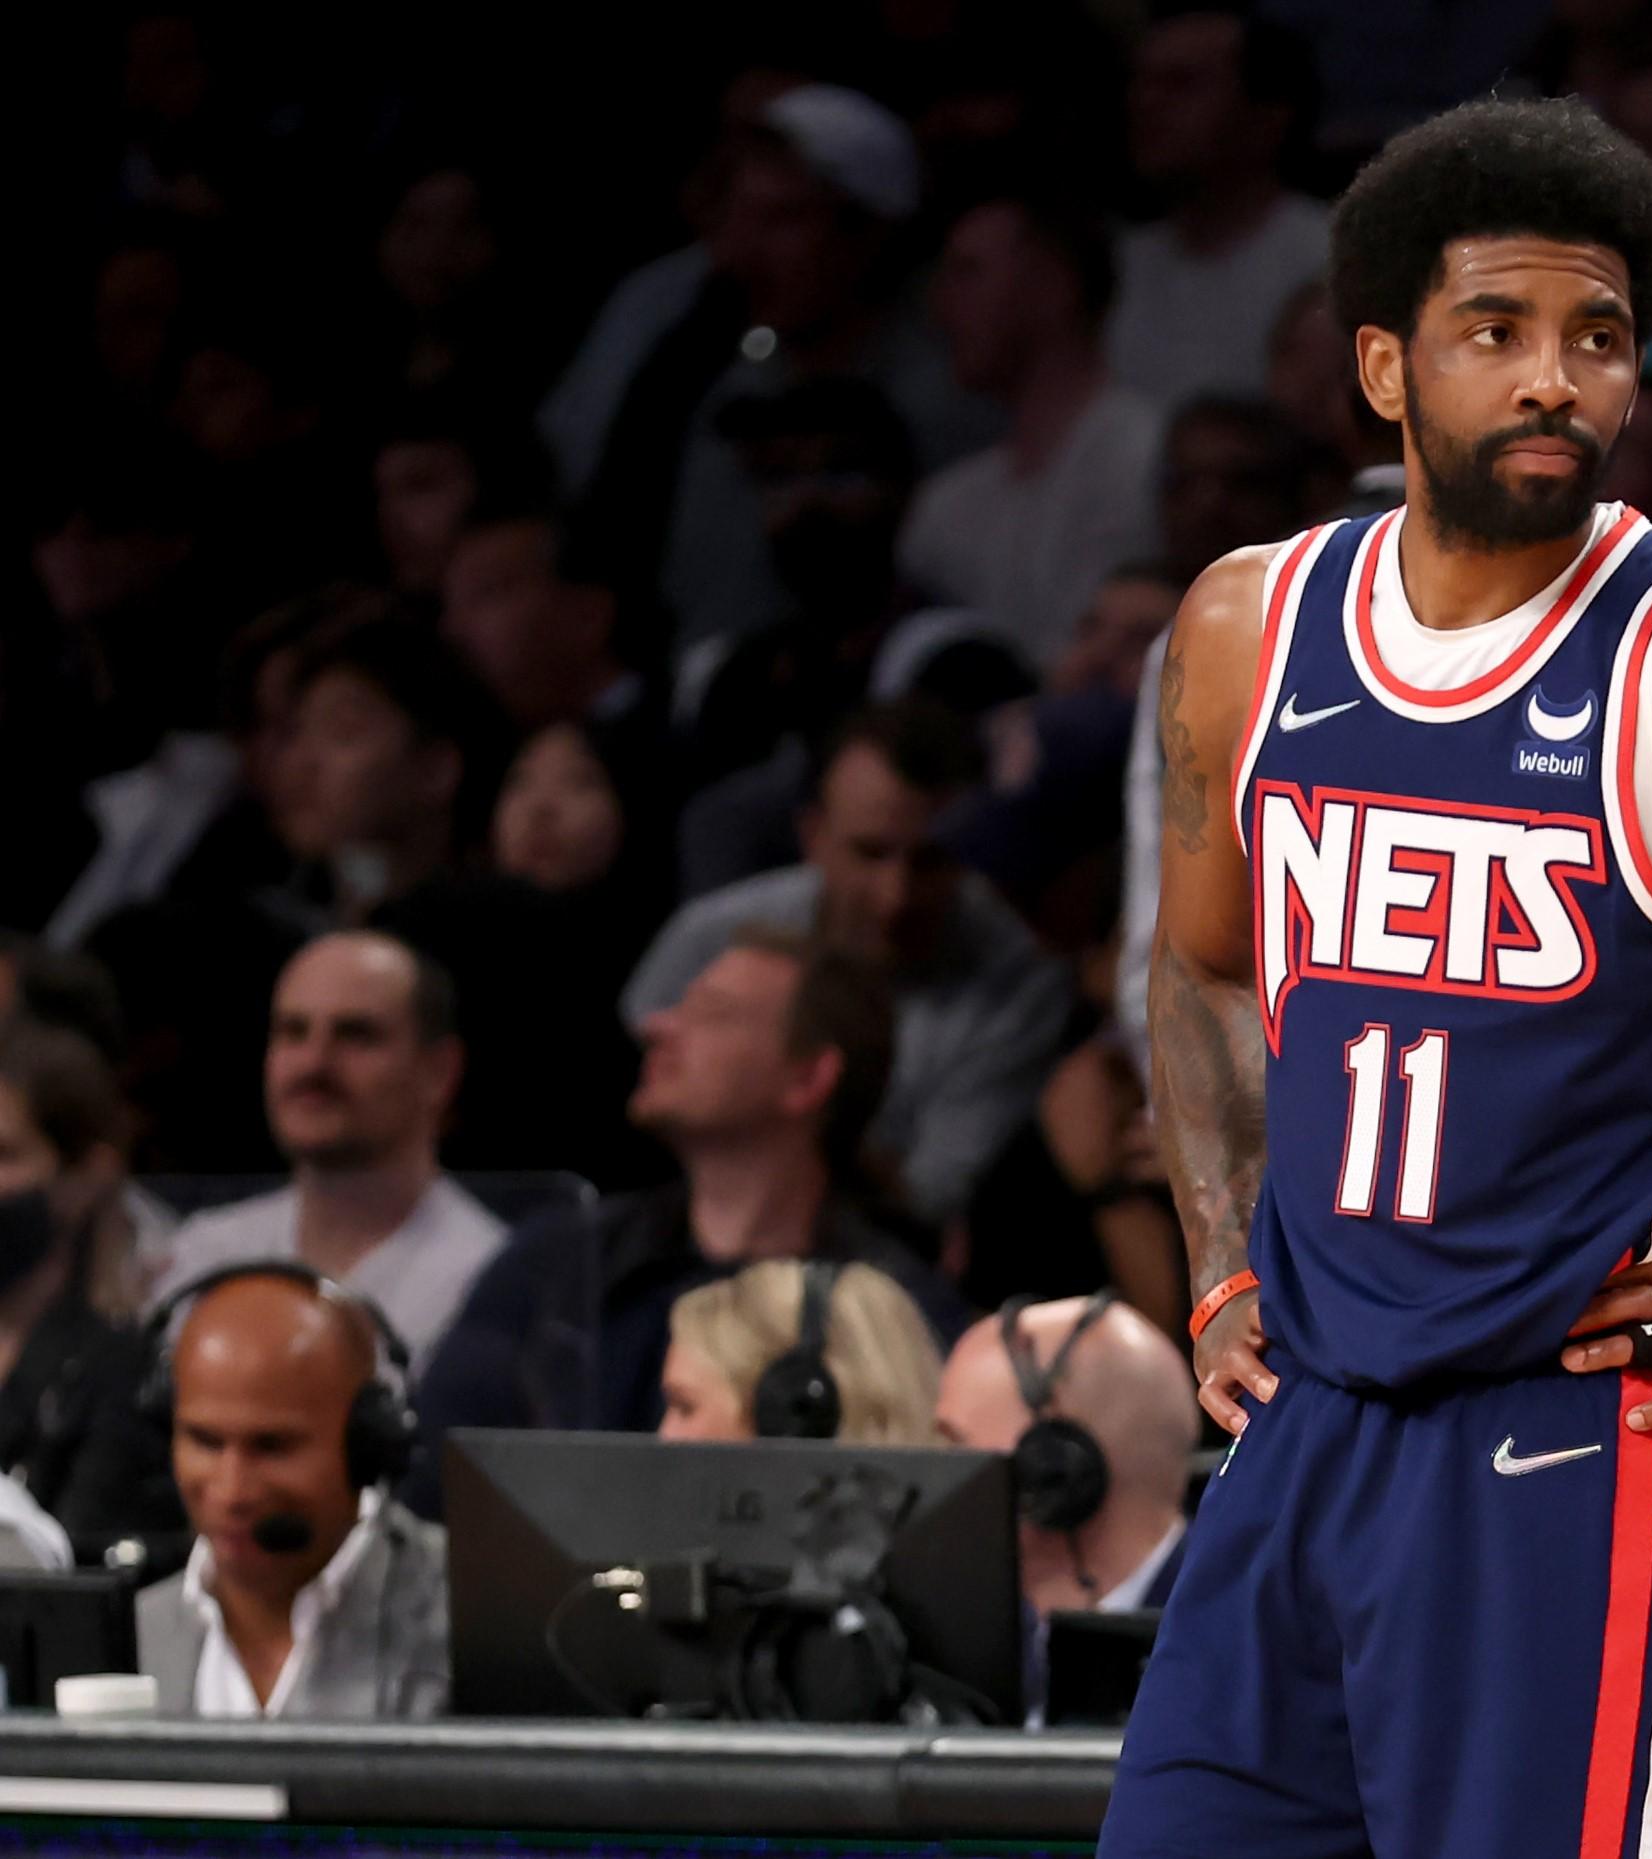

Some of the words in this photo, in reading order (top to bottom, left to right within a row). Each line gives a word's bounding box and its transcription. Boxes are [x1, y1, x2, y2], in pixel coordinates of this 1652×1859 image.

[1519, 749, 1584, 776] Webull
[1253, 778, 1607, 1058] NETS
[1334, 1022, 1449, 1225] 11
